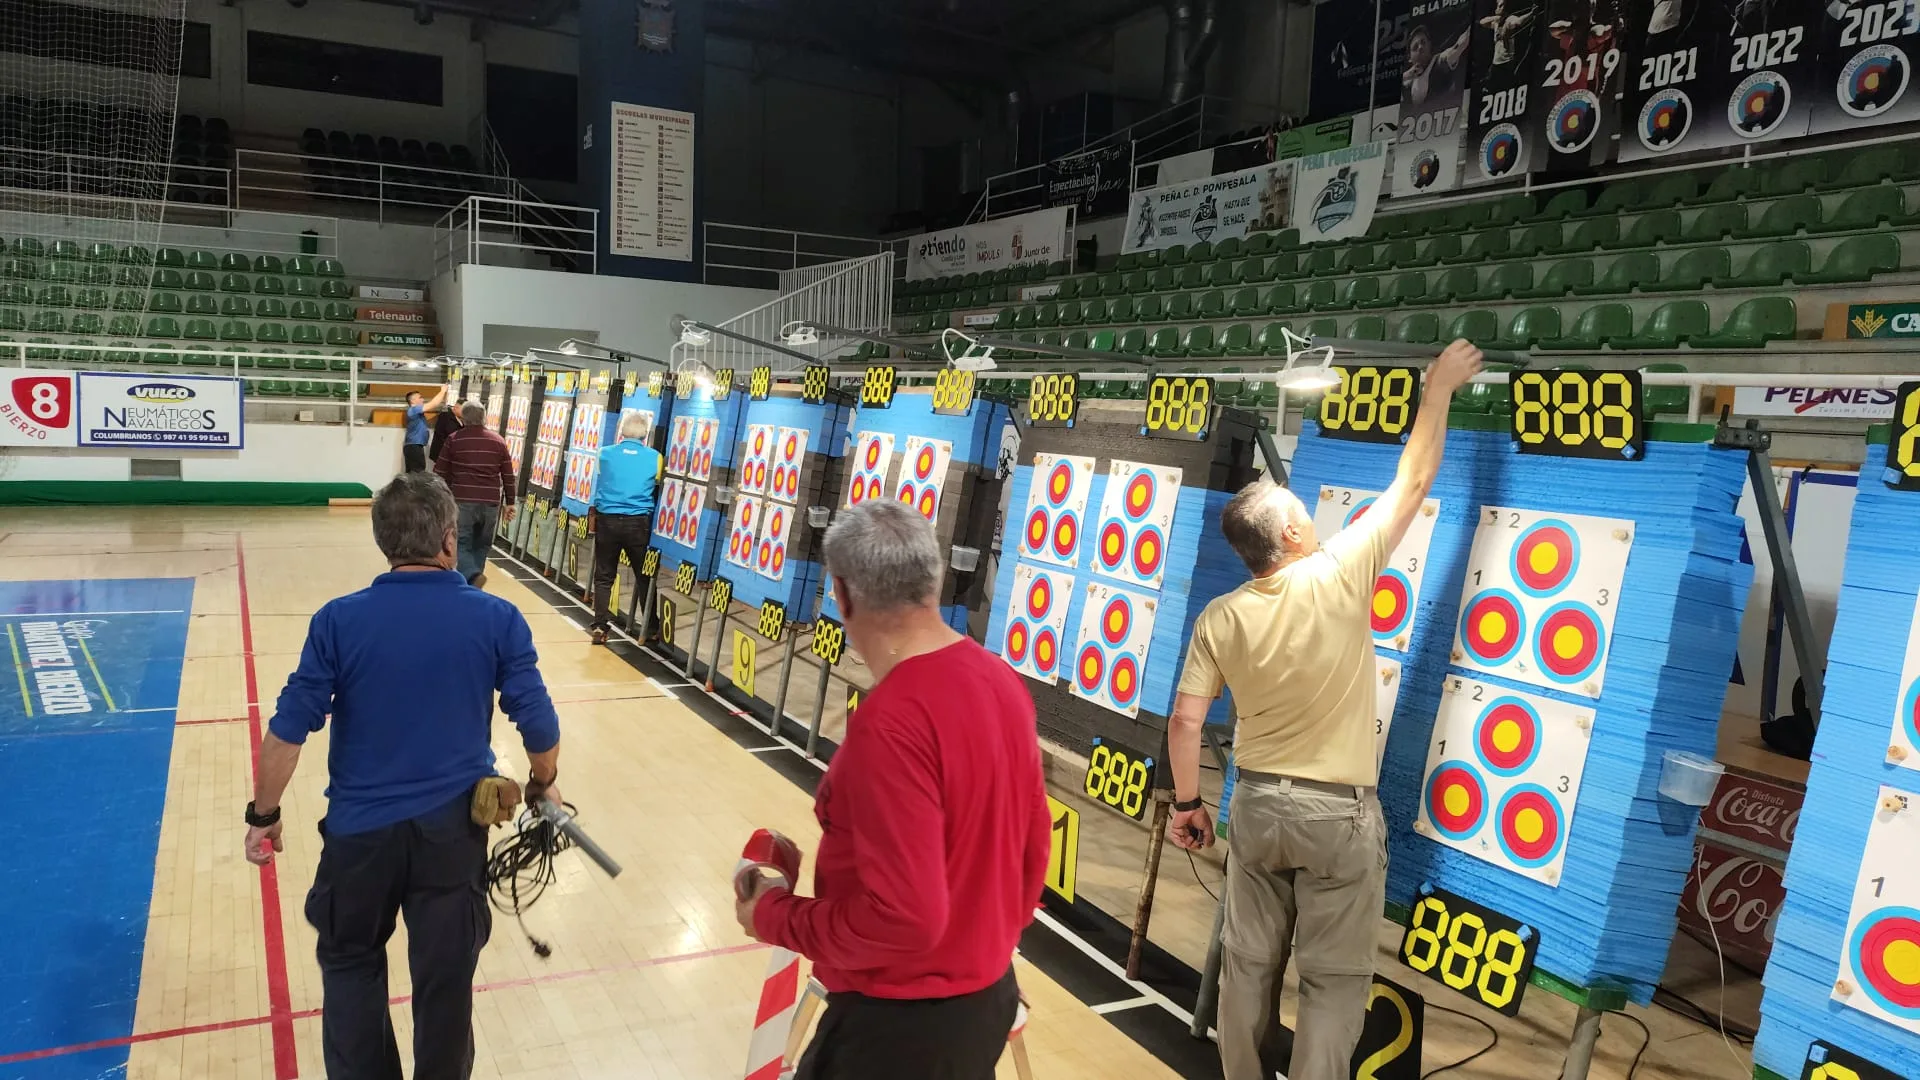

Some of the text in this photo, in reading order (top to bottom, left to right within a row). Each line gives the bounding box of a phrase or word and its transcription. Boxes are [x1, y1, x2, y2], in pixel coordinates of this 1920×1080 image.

[1412, 4, 1426, 16] DE
[1428, 1, 1439, 13] LA
[1839, 0, 1920, 47] 2023
[1730, 25, 1803, 72] 2022
[1541, 48, 1620, 90] 2019
[1639, 46, 1698, 91] 2021
[1479, 85, 1527, 125] 2018
[1399, 106, 1460, 144] 2017
[1160, 191, 1181, 204] PEÑA
[1202, 174, 1257, 194] PONFESALA
[919, 234, 966, 257] atiendo
[369, 310, 424, 322] Telenauto
[134, 387, 190, 400] VULCO
[751, 366, 770, 399] 888
[803, 366, 829, 399] 888
[862, 366, 894, 404] 888
[932, 368, 975, 411] 888
[1030, 374, 1076, 421] 888
[32, 382, 60, 420] 8
[1147, 377, 1210, 433] 888
[1320, 366, 1414, 434] 888
[1514, 371, 1634, 449] 888
[0, 403, 47, 440] BIERZO
[93, 432, 152, 441] COLUMBRIANOS
[163, 433, 177, 441] 987
[209, 434, 227, 442] Ext.1
[1047, 456, 1053, 467] 2
[1124, 463, 1130, 476] 2
[1104, 504, 1109, 516] 1
[1341, 491, 1352, 506] 2
[1161, 514, 1169, 528] 3
[1508, 512, 1521, 529] 2
[570, 543, 576, 577] 6
[642, 548, 660, 577] 888
[1026, 568, 1033, 579] 2
[1408, 557, 1418, 573] 3
[675, 562, 695, 596] 888
[1101, 587, 1107, 599] 2
[1473, 569, 1482, 586] 1
[711, 578, 731, 614] 888
[1597, 588, 1610, 606] 3
[662, 600, 672, 644] 8
[758, 602, 784, 641] 888
[1056, 617, 1062, 629] 3
[1083, 627, 1088, 639] 1
[813, 619, 843, 665] 888
[1138, 644, 1145, 656] 3
[739, 635, 751, 687] 9
[34, 669, 93, 715] BIERZO
[1472, 685, 1484, 702] 2
[1437, 739, 1447, 756] 1
[1086, 745, 1148, 817] 888
[1557, 775, 1570, 793] 3
[1751, 789, 1785, 806] Disfruta
[1871, 876, 1885, 898] 1
[1404, 896, 1526, 1008] 888
